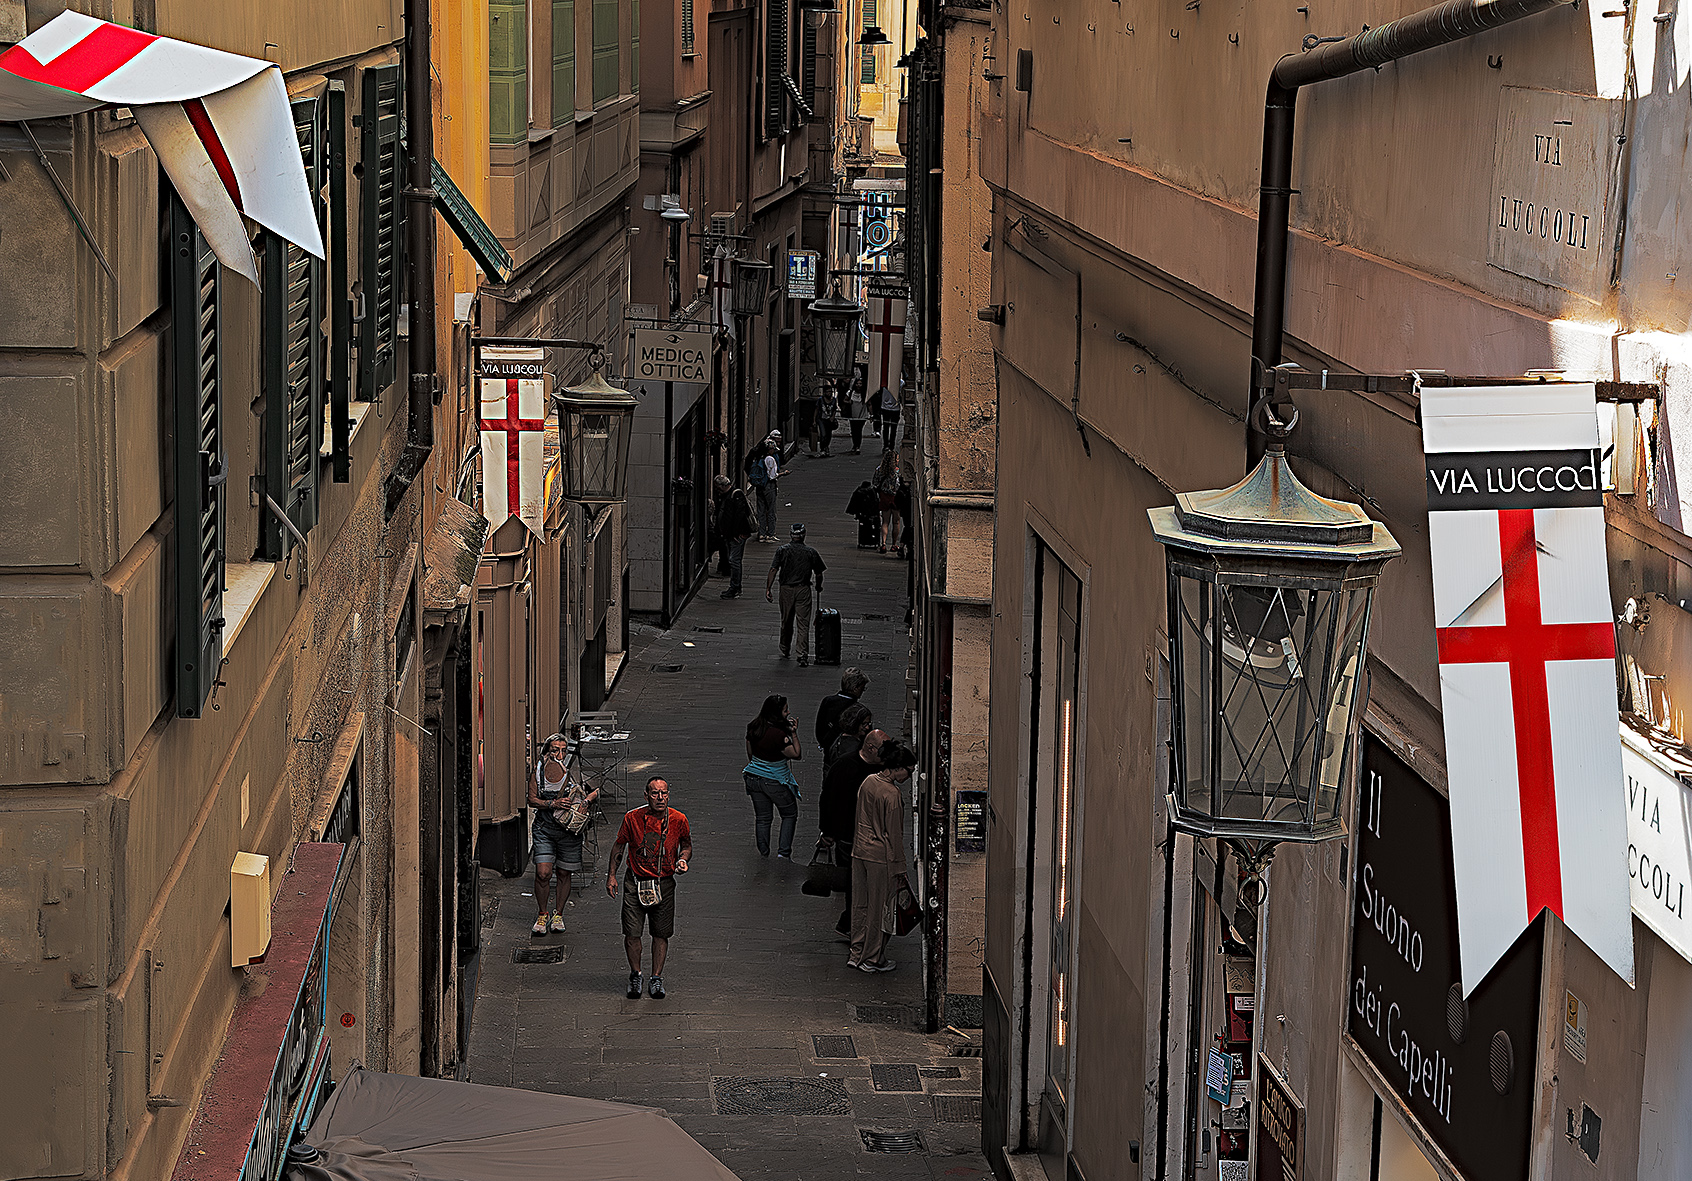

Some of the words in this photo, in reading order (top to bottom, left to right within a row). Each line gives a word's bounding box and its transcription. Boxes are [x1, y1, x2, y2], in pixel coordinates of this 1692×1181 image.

[1534, 133, 1562, 167] VIA
[1498, 194, 1591, 251] LUCCOLI
[482, 364, 500, 374] VIA
[640, 362, 705, 380] OTTICA
[641, 346, 706, 365] MEDICA
[1429, 468, 1480, 495] VIA
[1367, 769, 1382, 839] Il
[1628, 774, 1661, 835] VIA
[1361, 862, 1424, 973] Suono
[1355, 965, 1383, 1038] dei
[1387, 1001, 1453, 1124] Capelli
